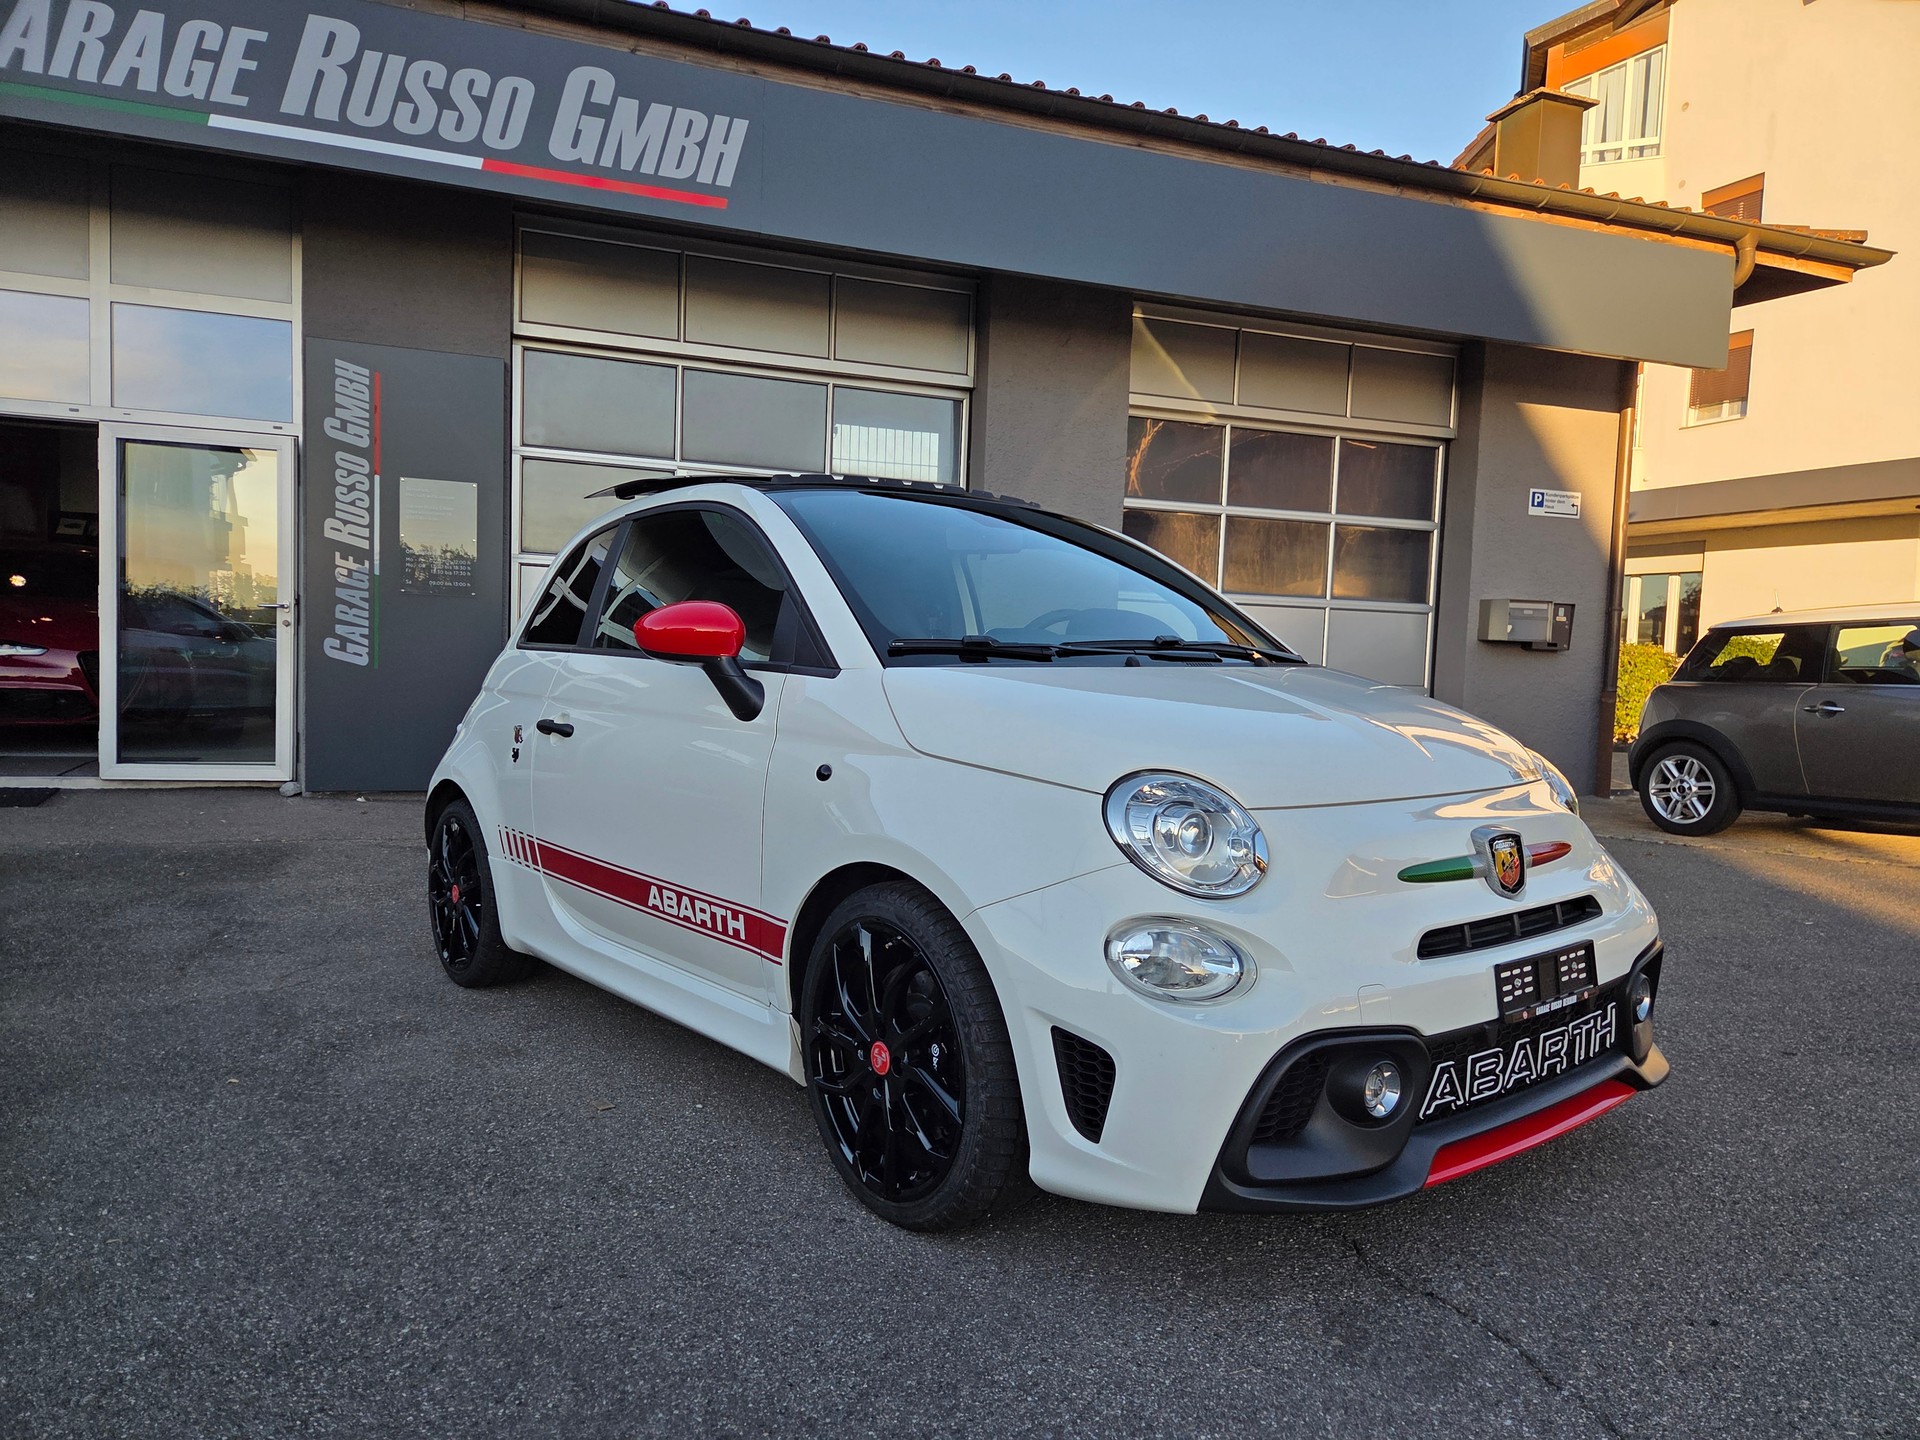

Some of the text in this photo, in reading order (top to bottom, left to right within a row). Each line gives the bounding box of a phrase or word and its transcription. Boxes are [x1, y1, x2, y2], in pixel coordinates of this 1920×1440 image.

[280, 14, 535, 151] RUSSO
[548, 66, 749, 188] GMBH
[324, 358, 370, 667] GARAGE RUSSO GMBH
[648, 885, 746, 940] ABARTH
[1419, 1002, 1616, 1120] ABARTH
